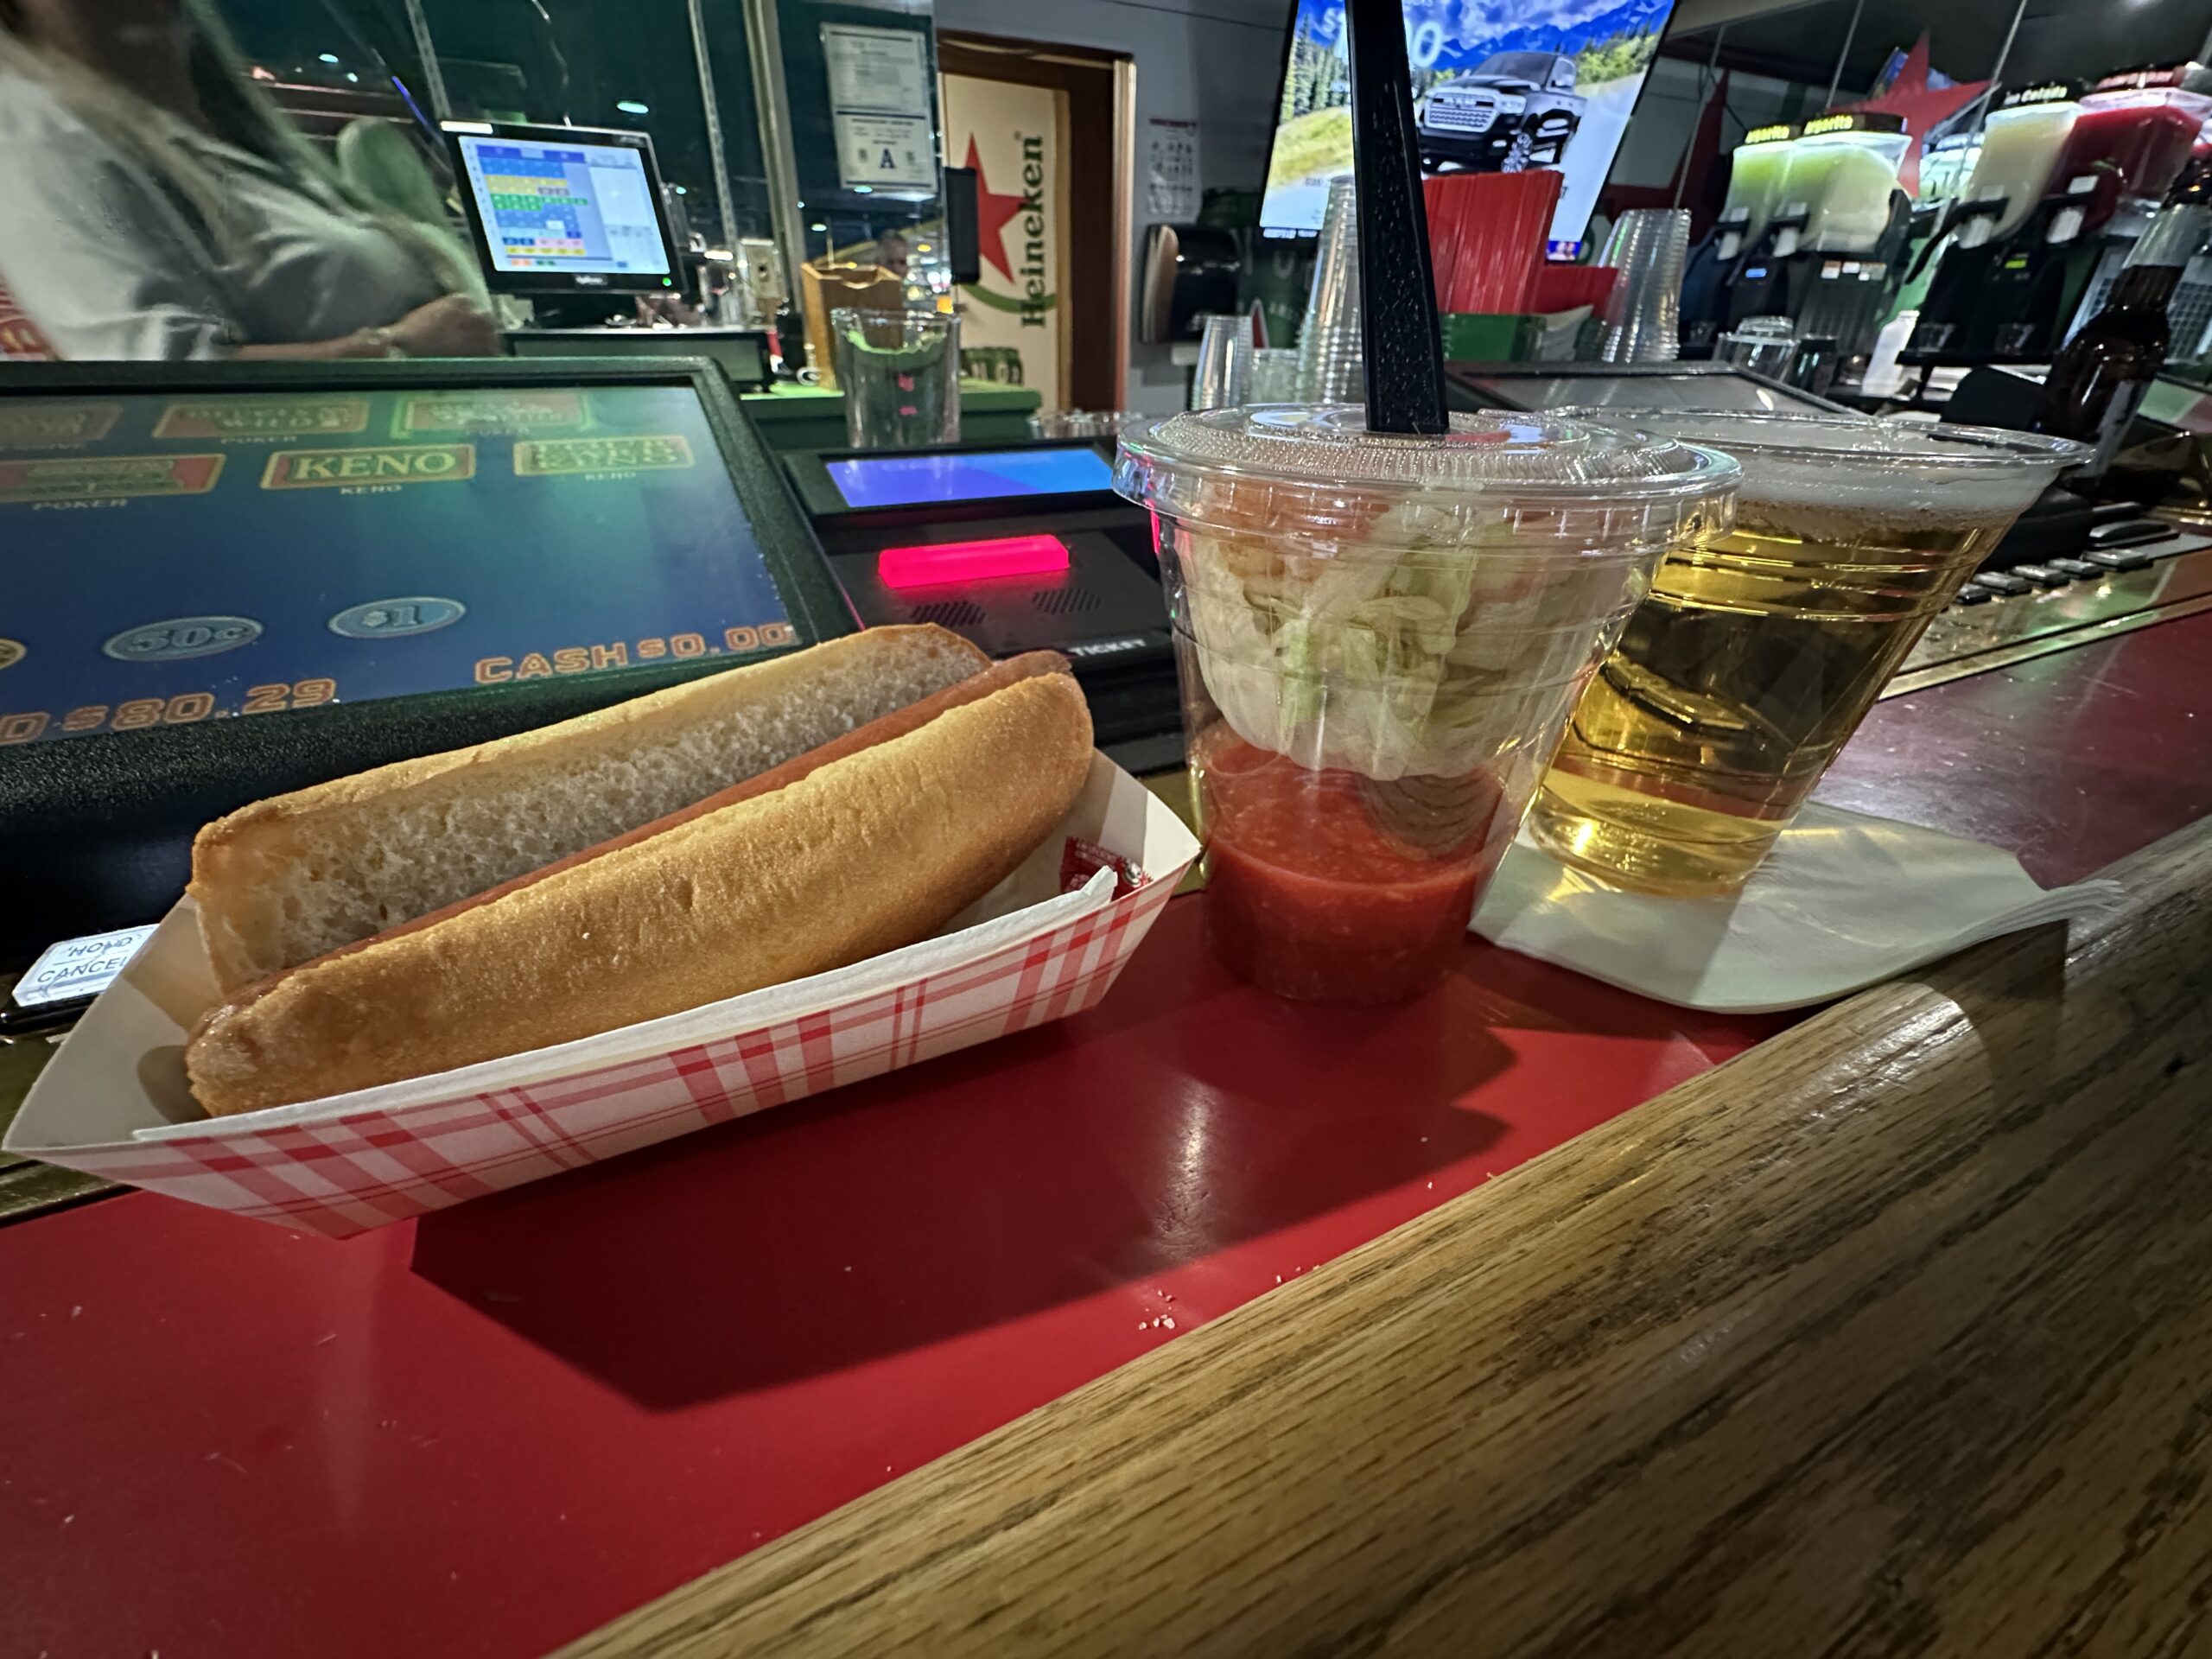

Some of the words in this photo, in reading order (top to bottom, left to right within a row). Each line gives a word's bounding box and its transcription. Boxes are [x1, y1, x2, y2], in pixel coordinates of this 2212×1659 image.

[879, 148, 896, 169] A
[1019, 135, 1046, 328] Heineken
[294, 451, 457, 481] KENO
[340, 483, 403, 495] KENO
[32, 498, 128, 511] POKER
[361, 604, 423, 627] $1
[474, 642, 628, 685] CASH
[637, 621, 793, 659] $0.00
[1067, 638, 1147, 657] TICKET
[61, 677, 336, 732] $80.29
